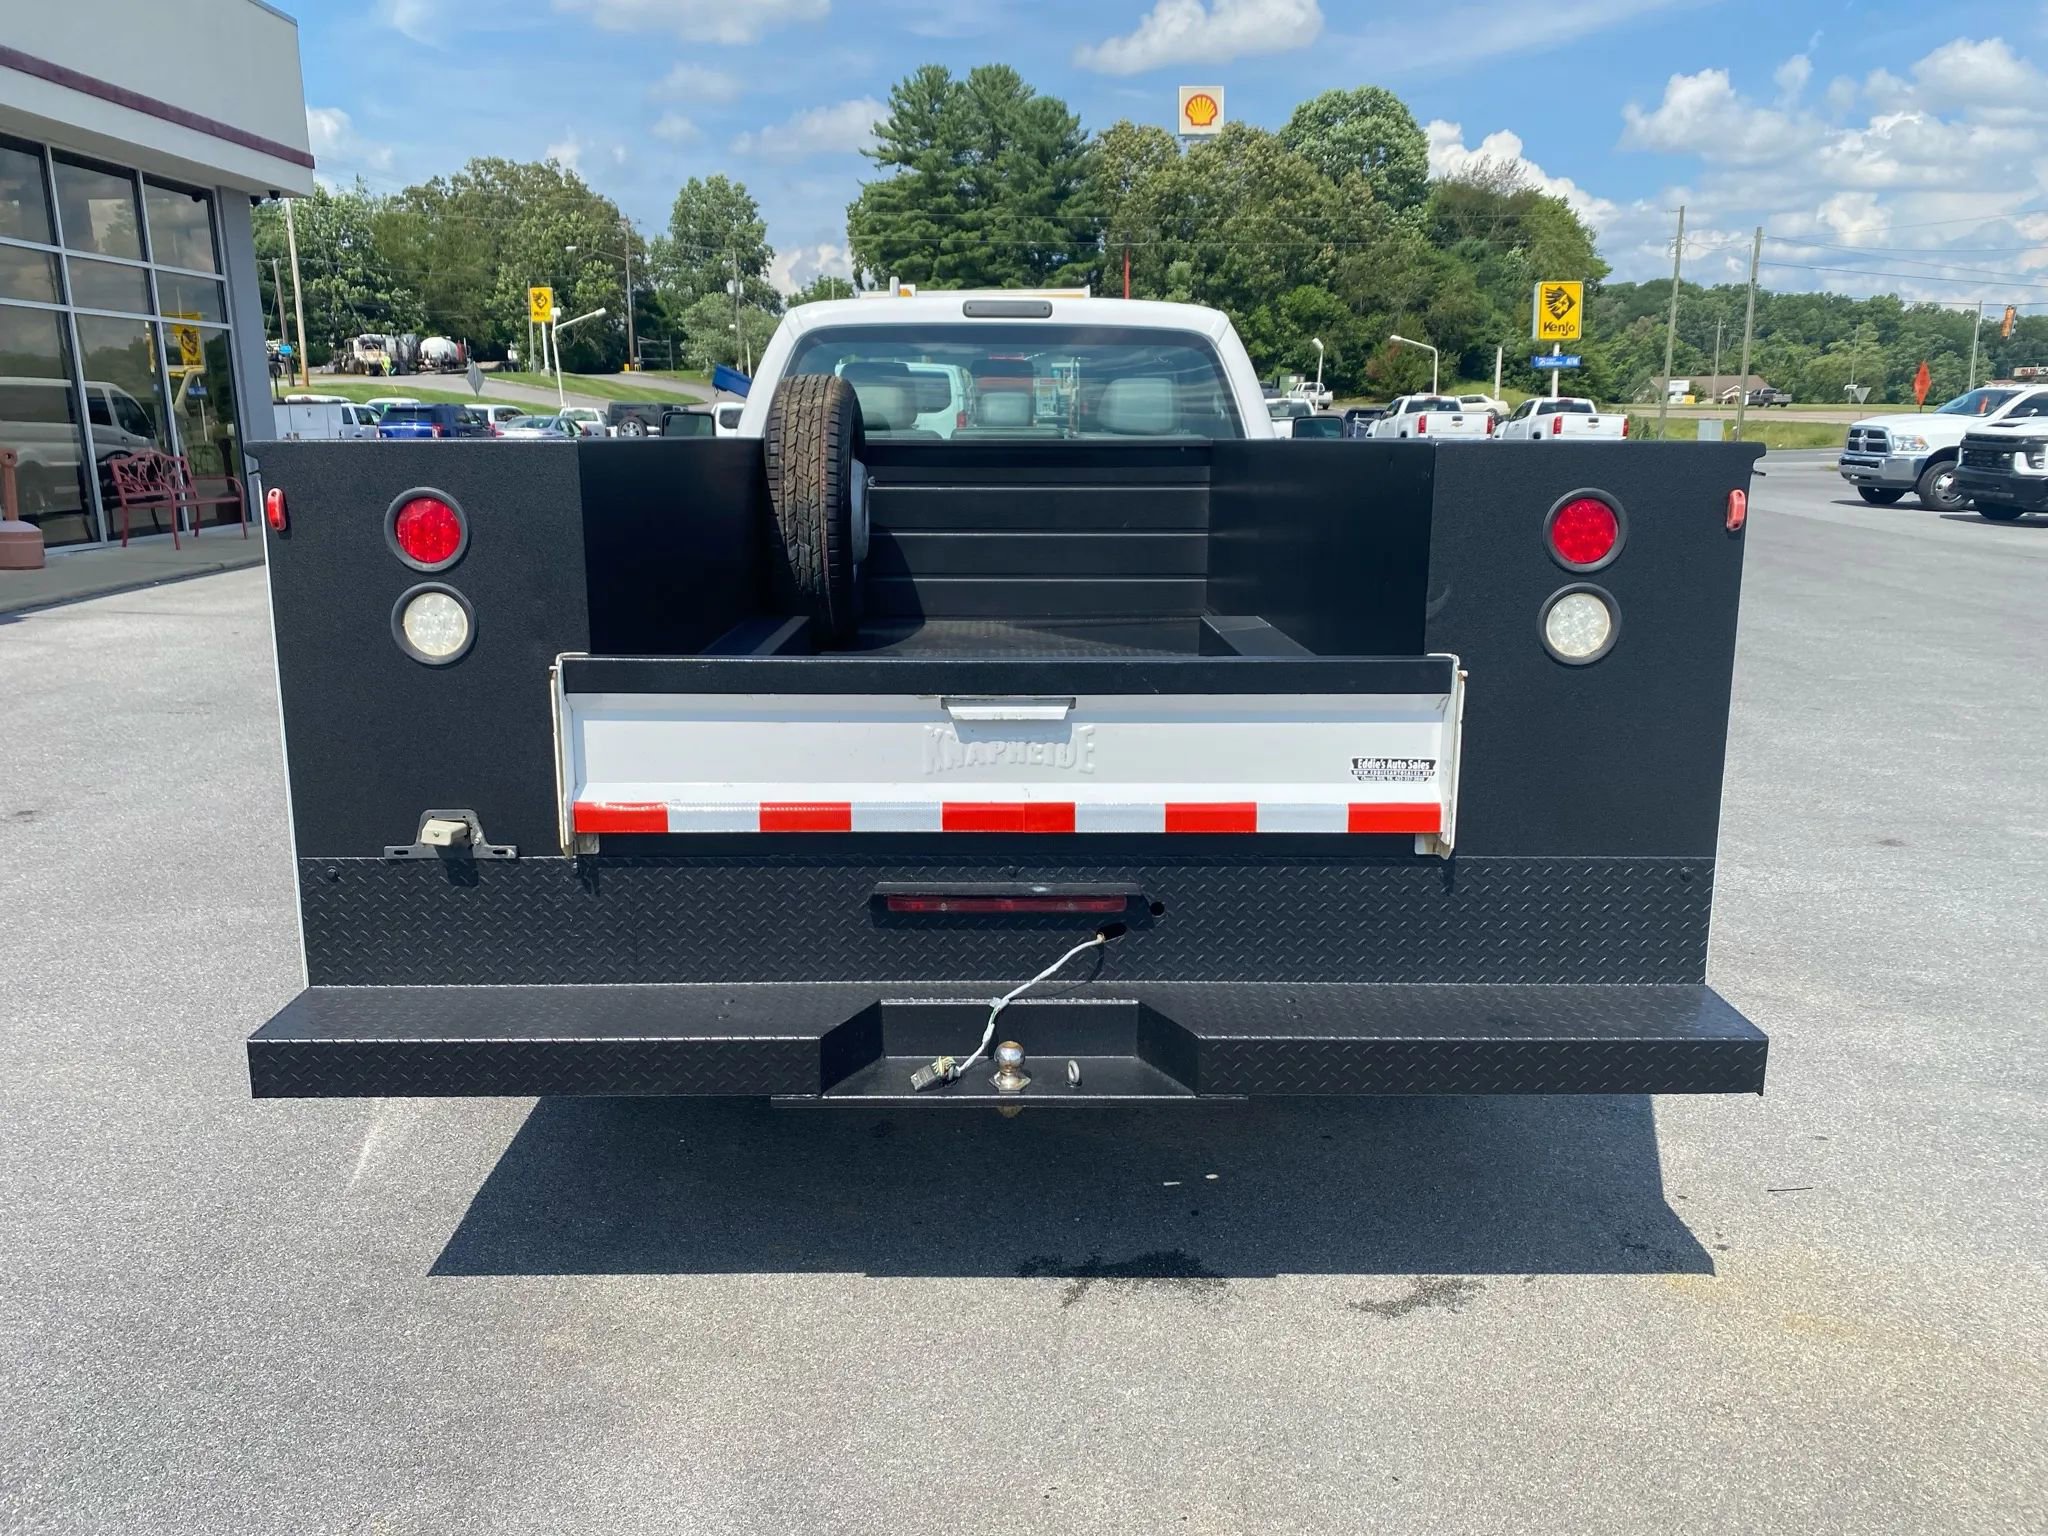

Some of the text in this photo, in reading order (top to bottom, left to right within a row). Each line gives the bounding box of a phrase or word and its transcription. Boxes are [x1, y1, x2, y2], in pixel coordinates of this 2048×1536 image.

[1543, 321, 1576, 336] Kenjo
[923, 724, 1096, 775] KNAPHEIDE
[1357, 758, 1430, 770] Eddie's Auto Sales
